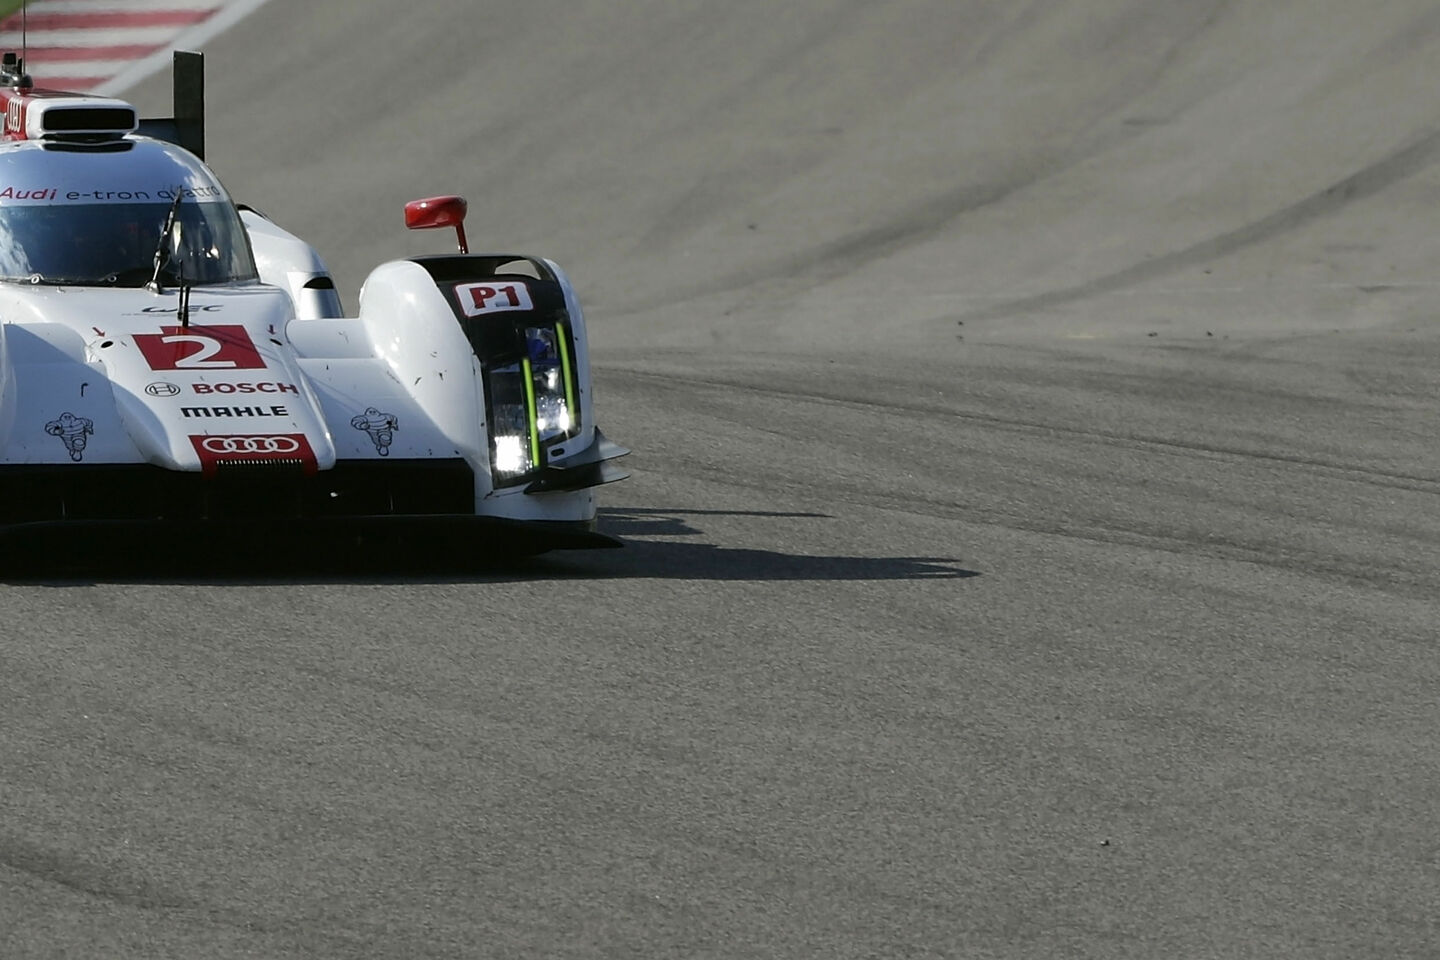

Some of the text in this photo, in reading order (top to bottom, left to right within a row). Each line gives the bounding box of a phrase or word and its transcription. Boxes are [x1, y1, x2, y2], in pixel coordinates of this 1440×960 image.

[65, 188, 150, 201] e-tron
[469, 286, 521, 310] P1
[161, 335, 238, 368] 2
[191, 382, 299, 395] BOSCH
[180, 405, 289, 417] MAHLE
